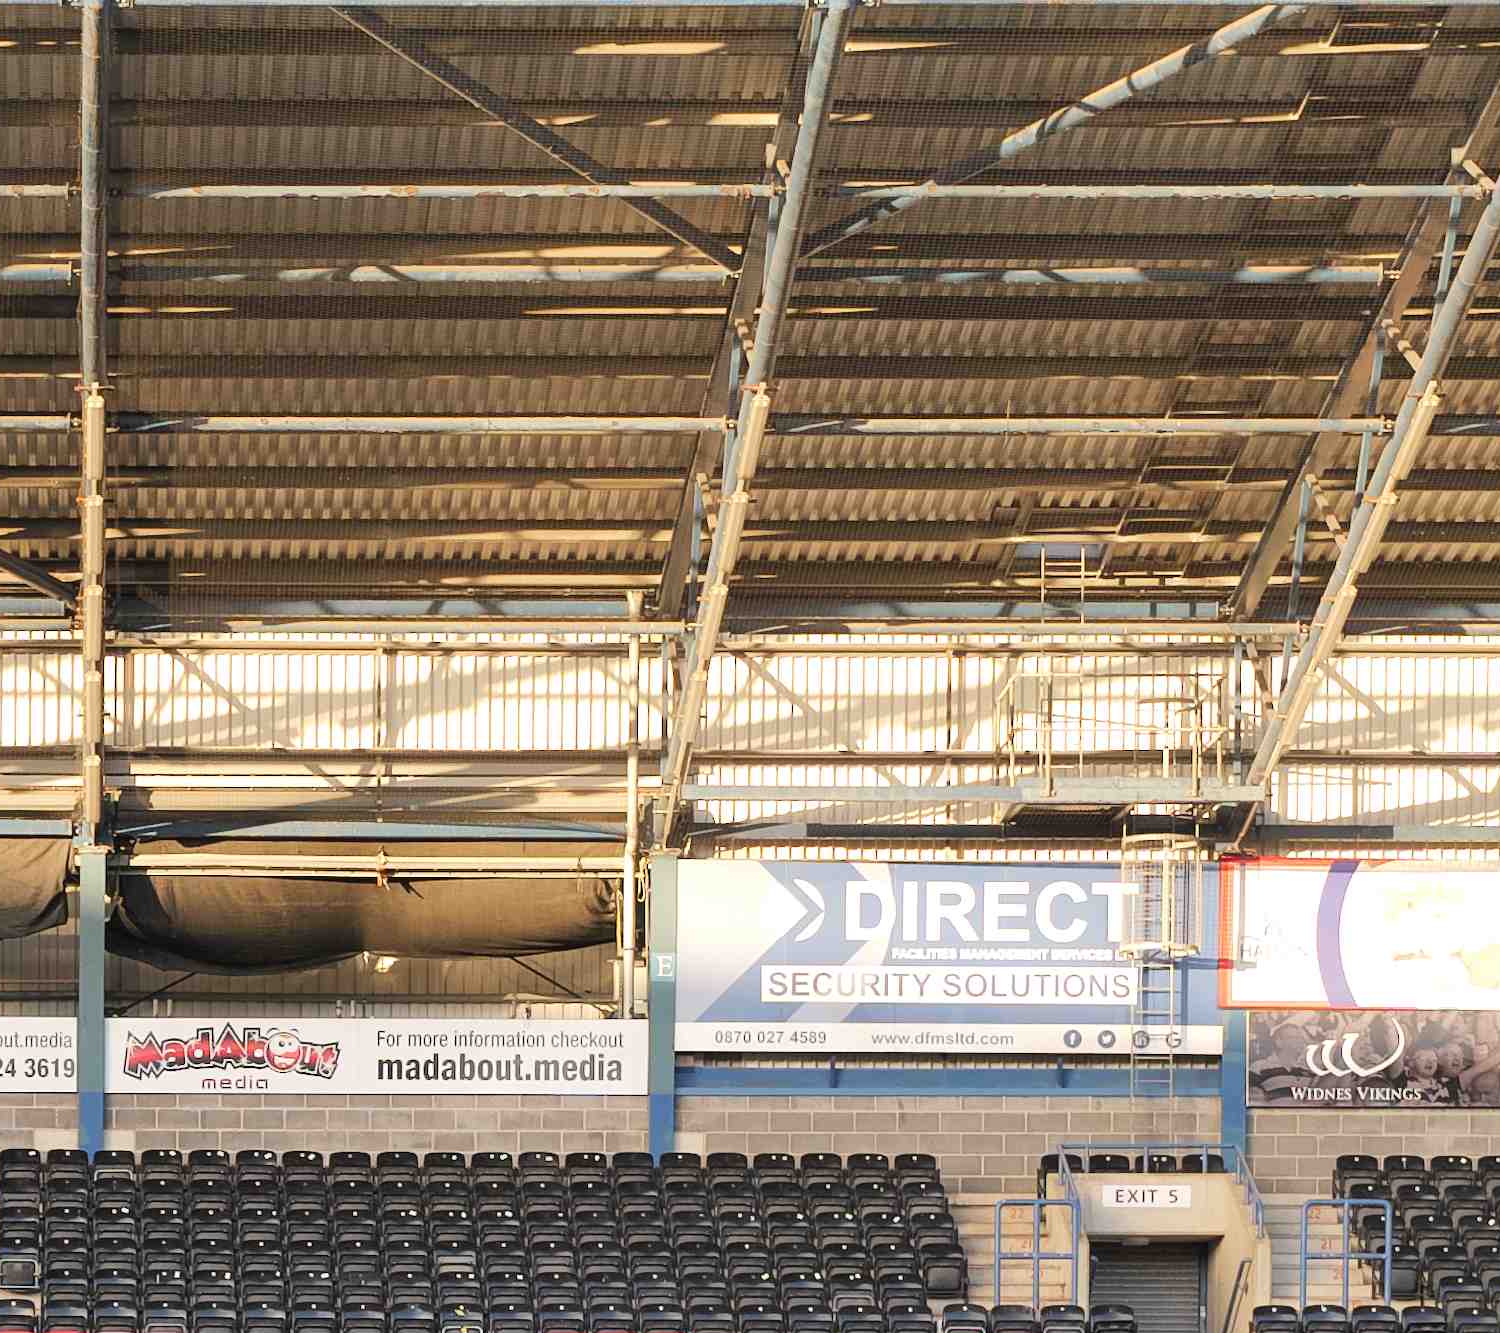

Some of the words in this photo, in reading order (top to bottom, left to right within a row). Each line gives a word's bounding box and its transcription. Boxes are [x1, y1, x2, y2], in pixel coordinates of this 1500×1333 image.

[843, 879, 1139, 944] DIRECT
[657, 956, 673, 977] E
[768, 973, 931, 998] SECURITY
[943, 973, 1131, 999] SOLUTIONS
[377, 1030, 403, 1049] For
[408, 1030, 449, 1049] more
[453, 1030, 546, 1049] information
[551, 1030, 624, 1049] checkout
[715, 1030, 753, 1044] 0870
[757, 1030, 784, 1044] 027
[790, 1030, 827, 1044] 4589
[871, 1031, 1015, 1047] www.dfmsltd.com
[24, 1056, 75, 1079] 3619
[377, 1053, 623, 1082] madabout.media
[201, 1077, 269, 1090] media
[1291, 1085, 1352, 1101] WIDNES
[1356, 1085, 1422, 1101] VIKINGS
[1115, 1189, 1158, 1203] EXIT
[1168, 1189, 1179, 1203] 5
